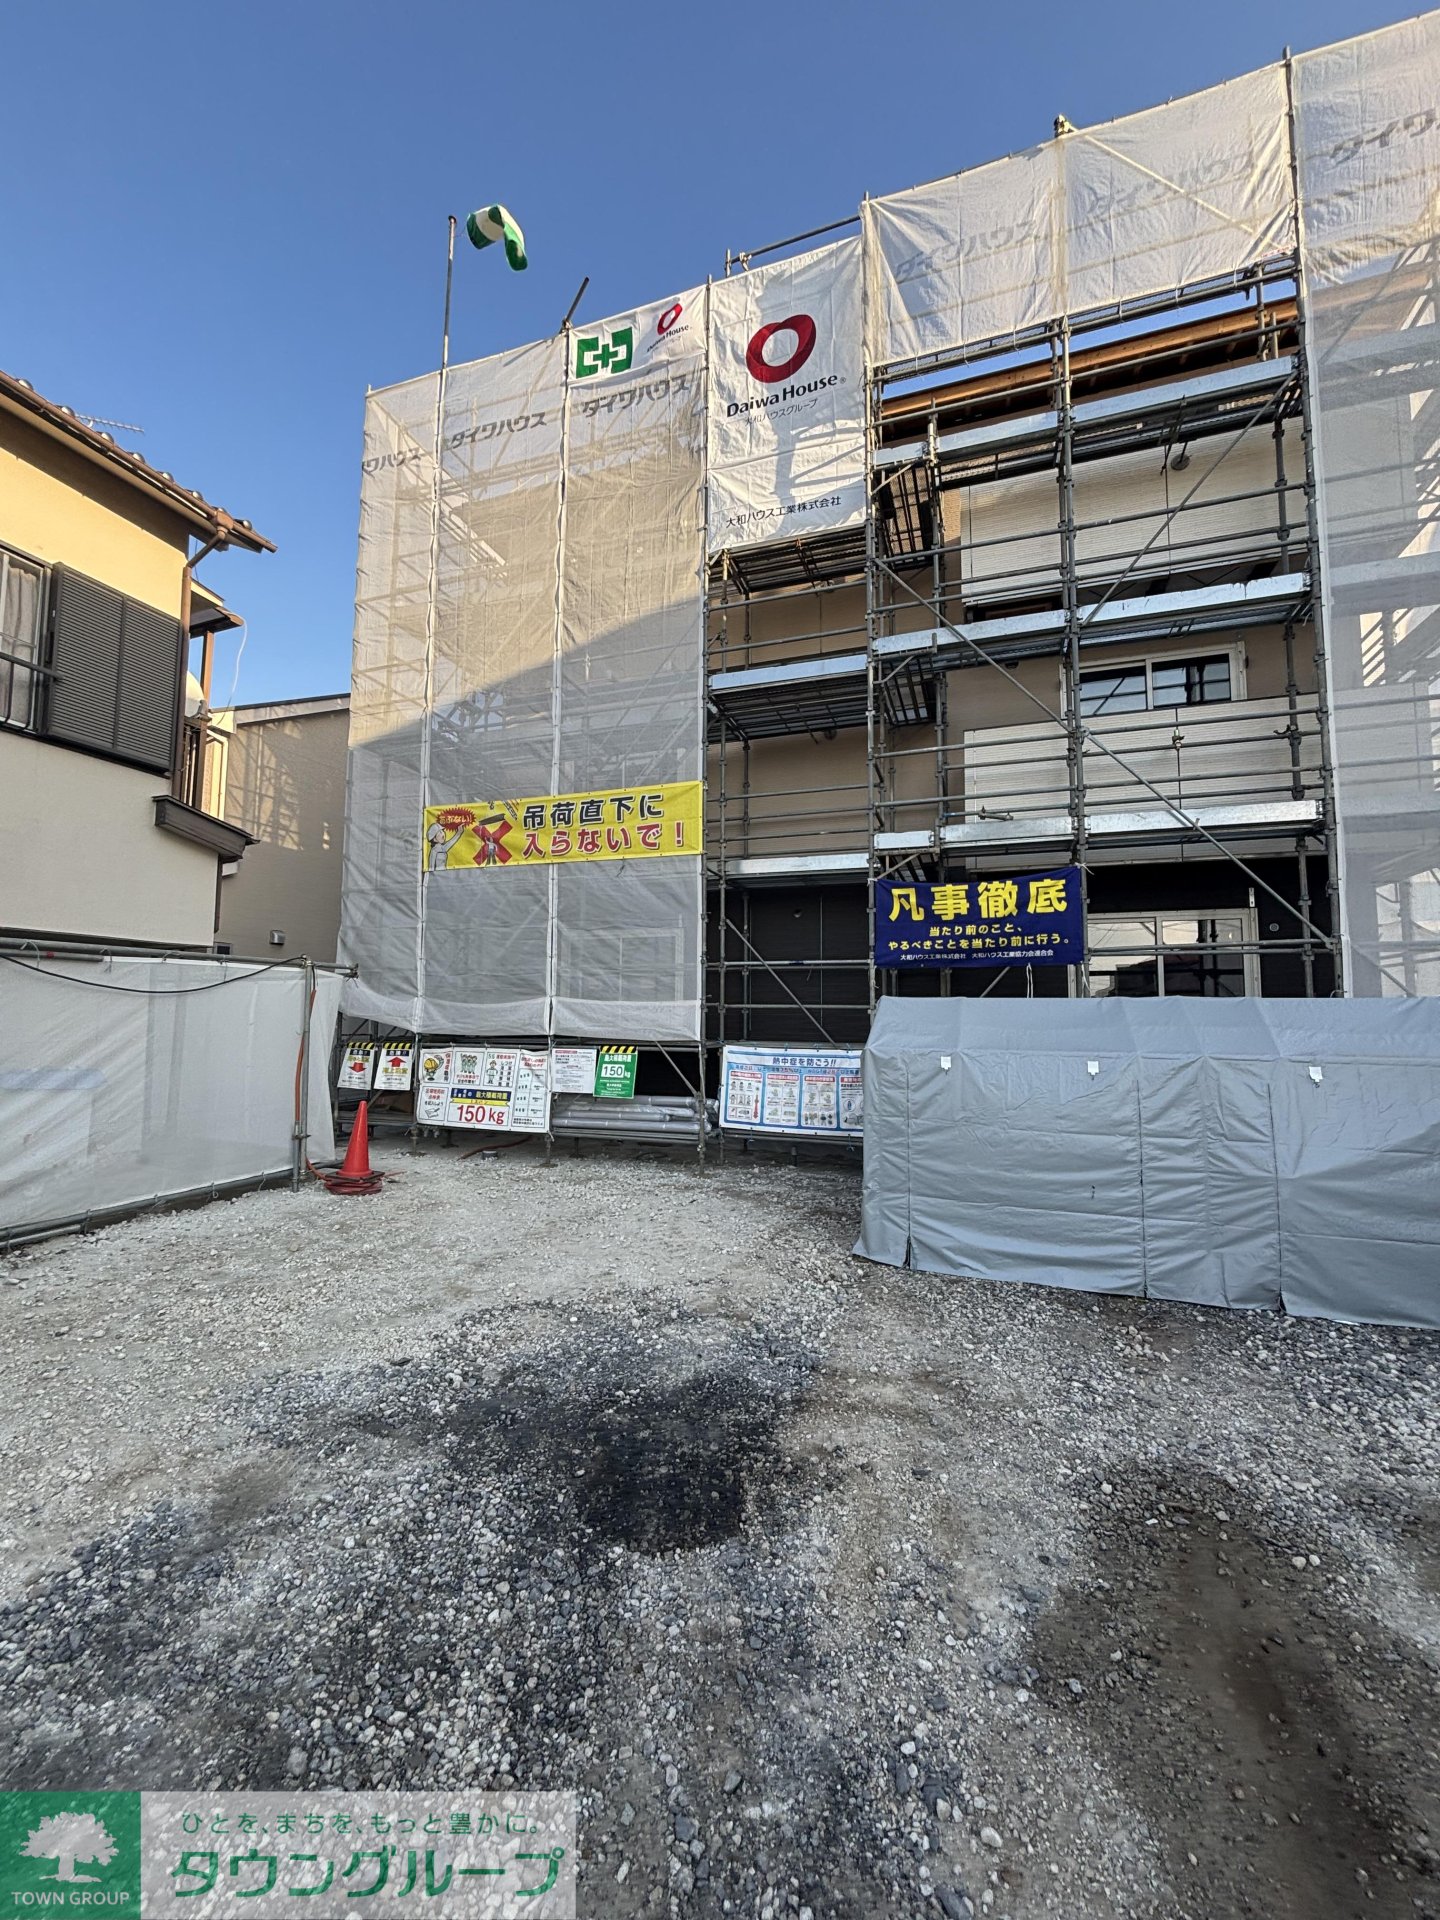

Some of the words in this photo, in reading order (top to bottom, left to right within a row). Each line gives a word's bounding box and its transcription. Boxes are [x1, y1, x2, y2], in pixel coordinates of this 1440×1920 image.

[1327, 108, 1440, 172] ダイワ
[582, 374, 690, 418] ダイワハウス
[726, 393, 780, 418] Daiwa
[782, 374, 839, 402] House
[450, 411, 548, 450] ダイワハウス
[725, 495, 842, 529] 大和ハウス工業株式会社
[523, 794, 664, 830] 吊荷直下に
[523, 822, 686, 859] 入らないで！
[888, 878, 1068, 922] 凡事徹底
[888, 933, 1069, 951] やるべきことを当たり前に行う。
[929, 923, 1022, 938] 当たり前のこと、
[603, 1065, 624, 1077] 150
[457, 1104, 486, 1123] 150
[488, 1107, 505, 1125] kg
